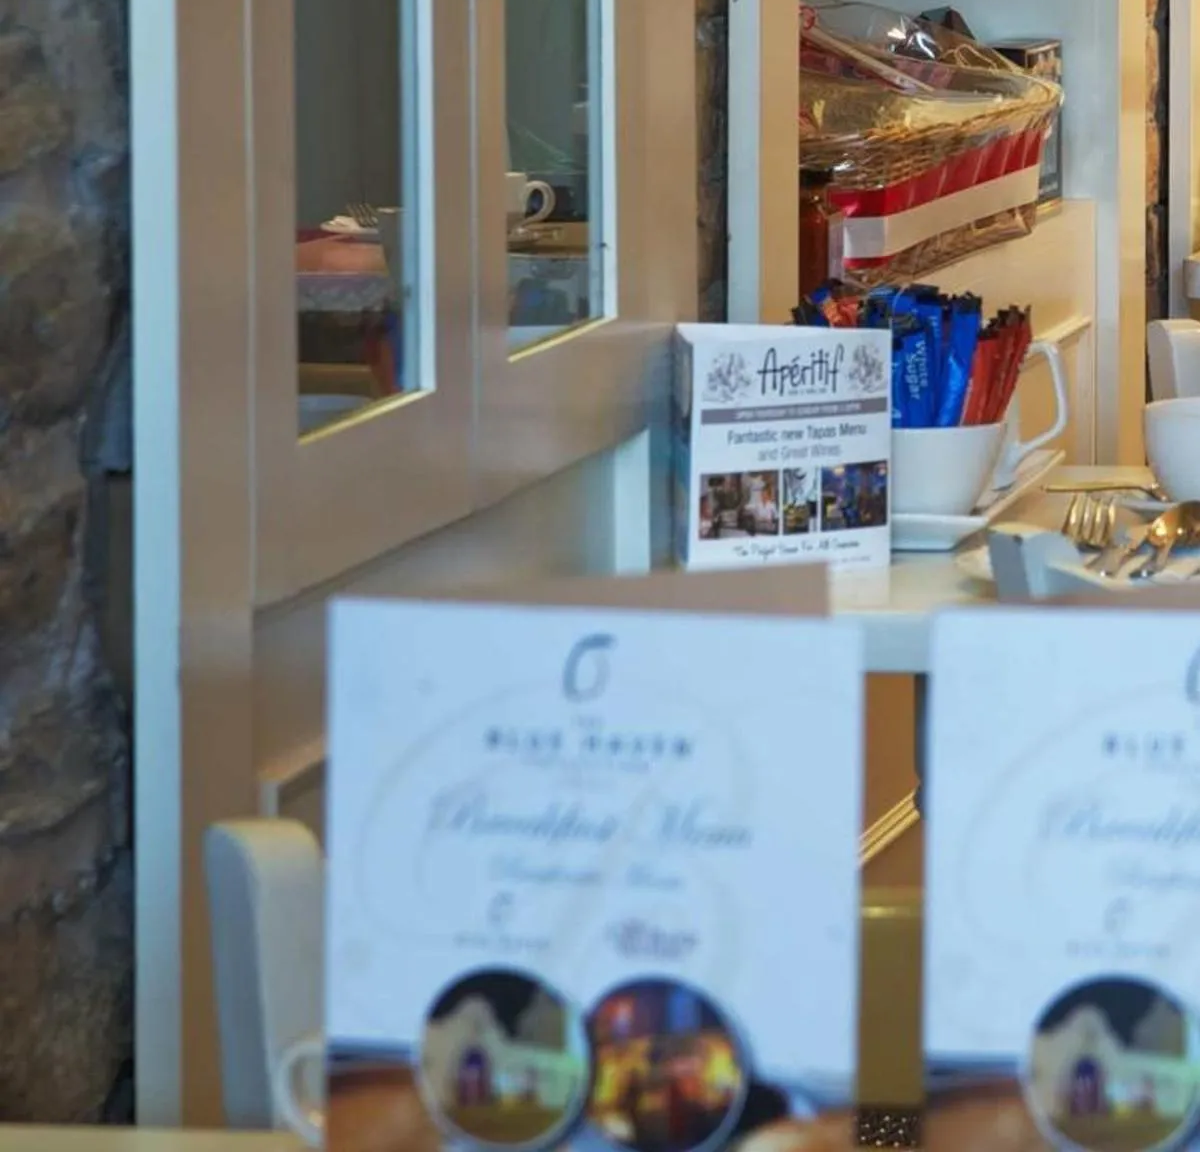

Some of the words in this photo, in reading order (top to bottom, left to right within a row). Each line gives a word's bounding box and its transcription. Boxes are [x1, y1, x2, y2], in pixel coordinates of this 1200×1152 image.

[757, 343, 845, 396] Apéritif
[727, 428, 778, 445] Fantastic
[781, 428, 804, 441] new
[806, 424, 837, 440] Tapas
[839, 422, 868, 436] Menu
